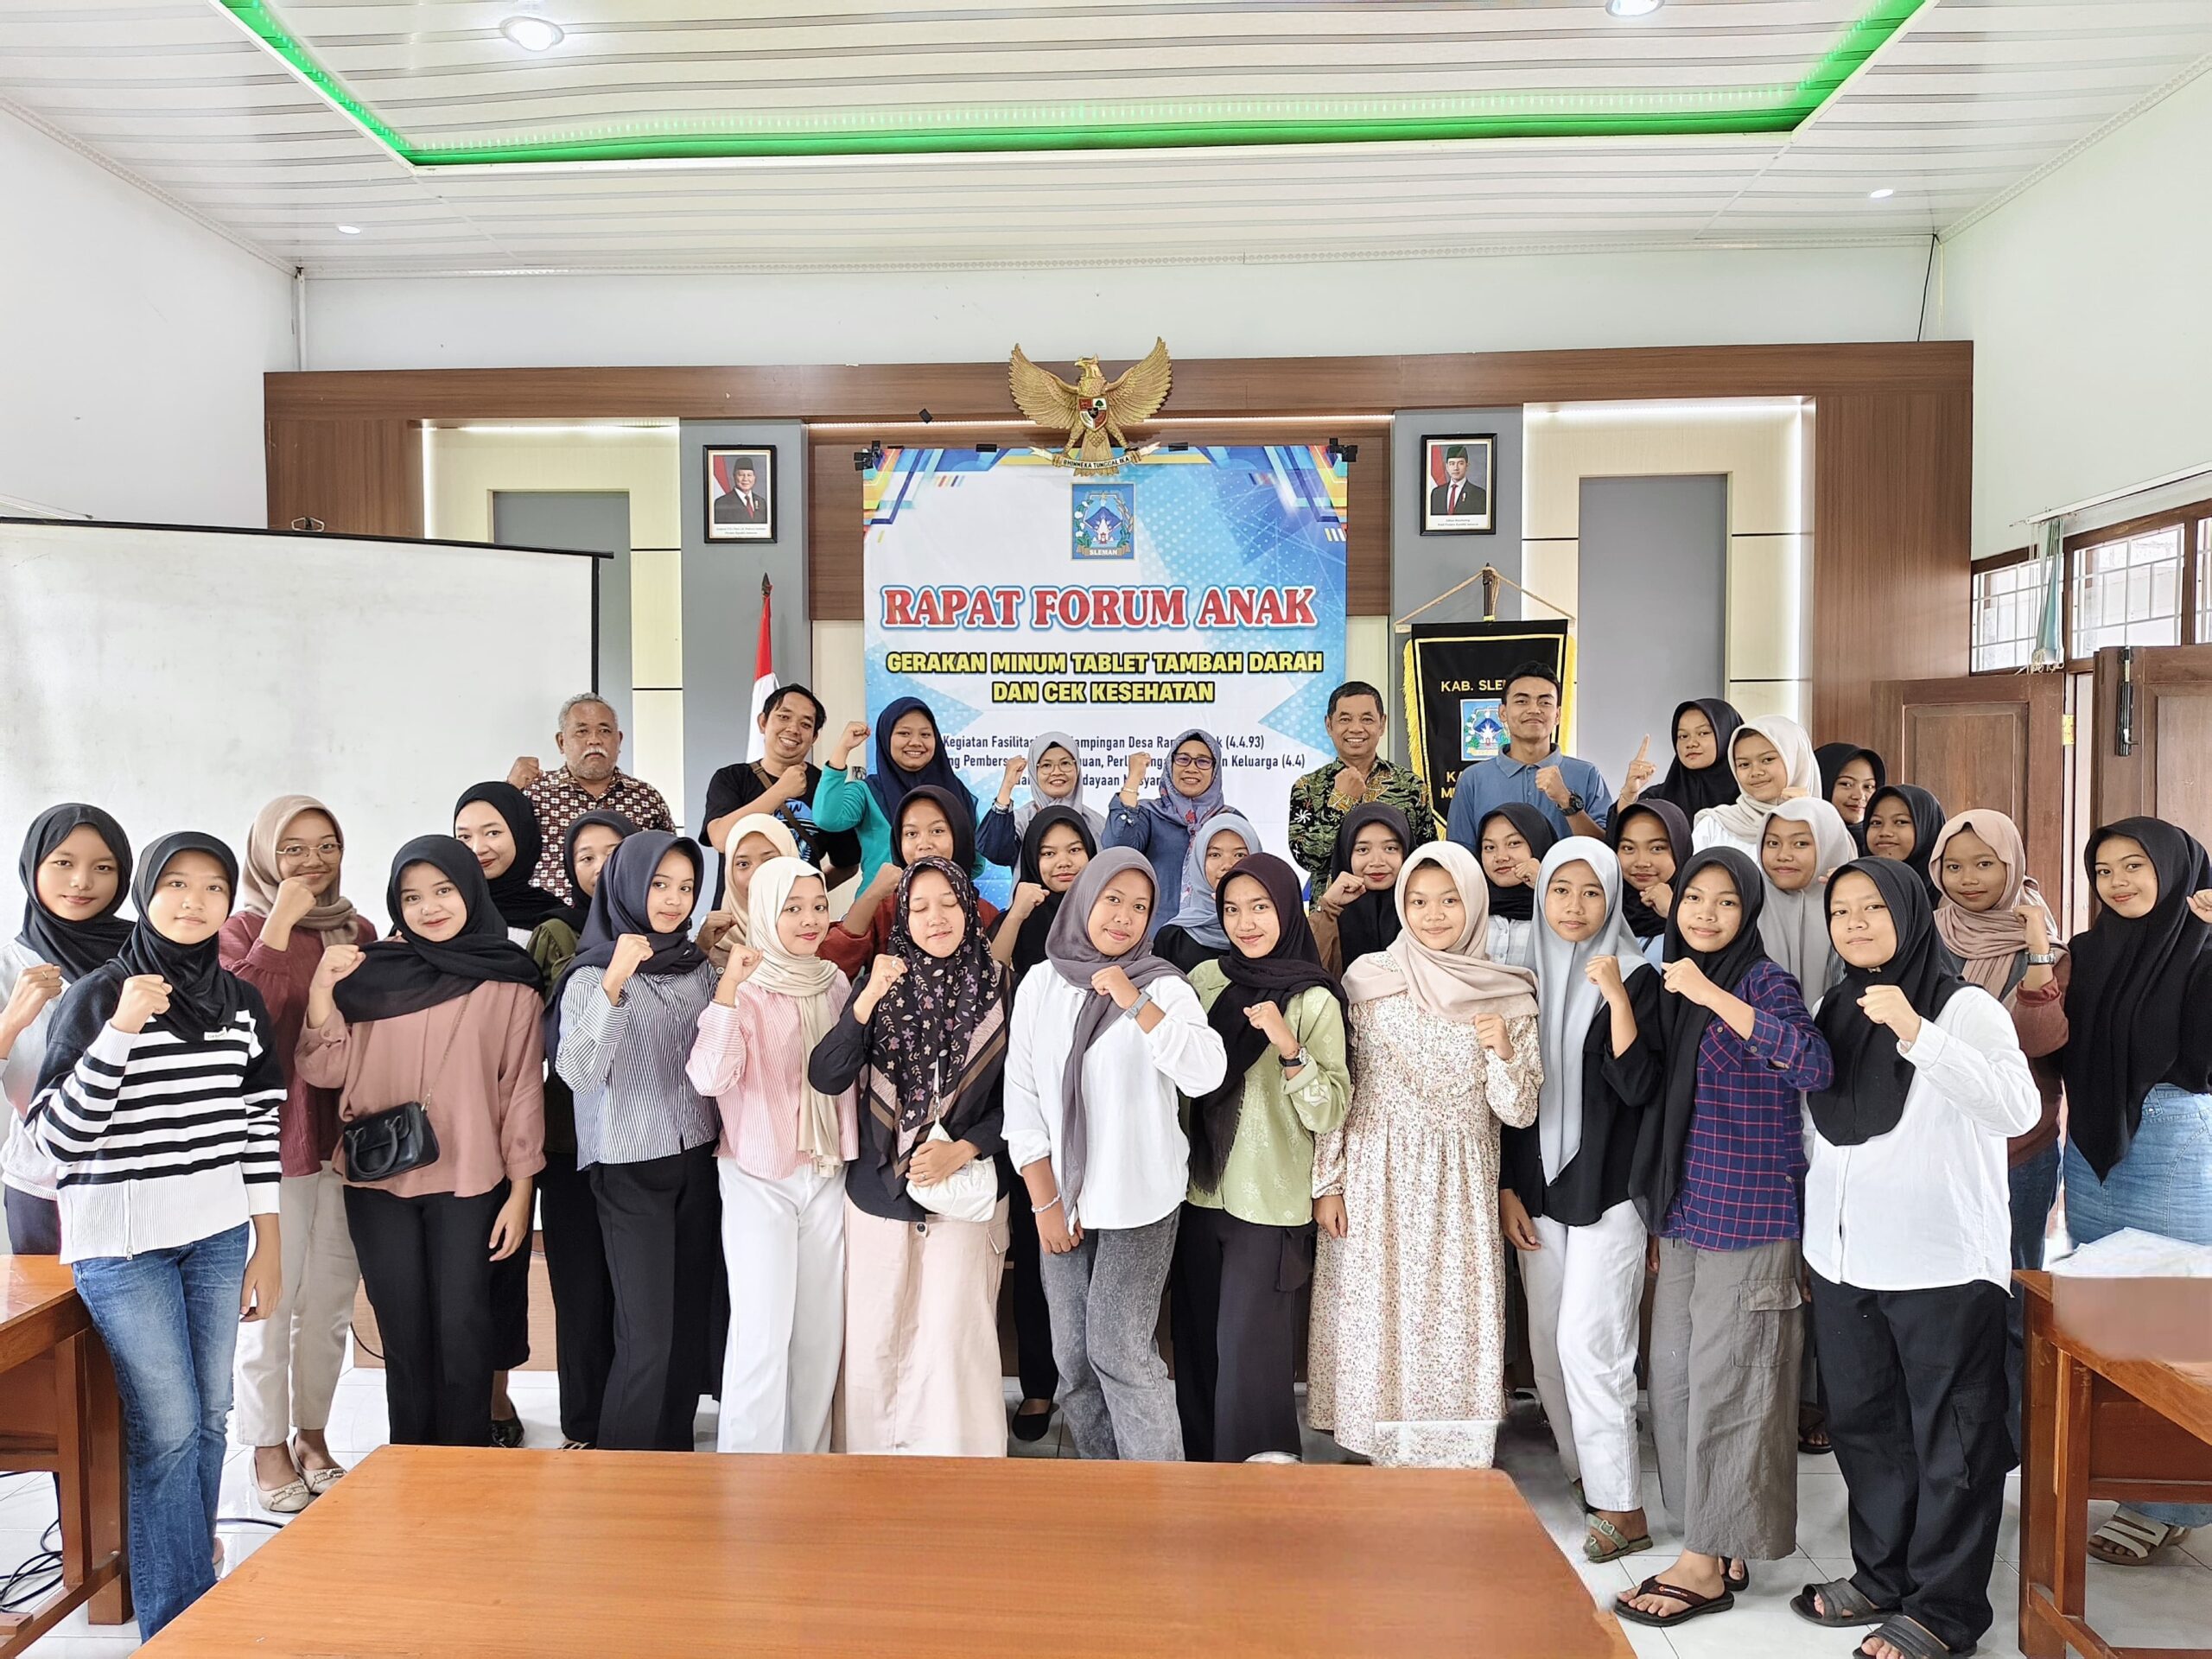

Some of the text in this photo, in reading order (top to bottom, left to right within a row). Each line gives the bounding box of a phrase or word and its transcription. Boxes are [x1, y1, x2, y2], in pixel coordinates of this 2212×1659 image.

[882, 586, 1318, 628] RAPAT FORUM ANAK
[887, 652, 1324, 673] GERAKAN MINUM TABLET TAMBAH DARAH
[992, 681, 1215, 703] DAN CEK KESEHATAN
[1440, 679, 1507, 692] KAB. SLE
[943, 734, 988, 751] Kegiatan
[1071, 735, 1125, 752] ampingan
[1128, 735, 1154, 748] Desa
[1225, 734, 1265, 750] (4.4.93)
[1231, 754, 1279, 770] Keluarga
[1281, 753, 1306, 769] (4.4)
